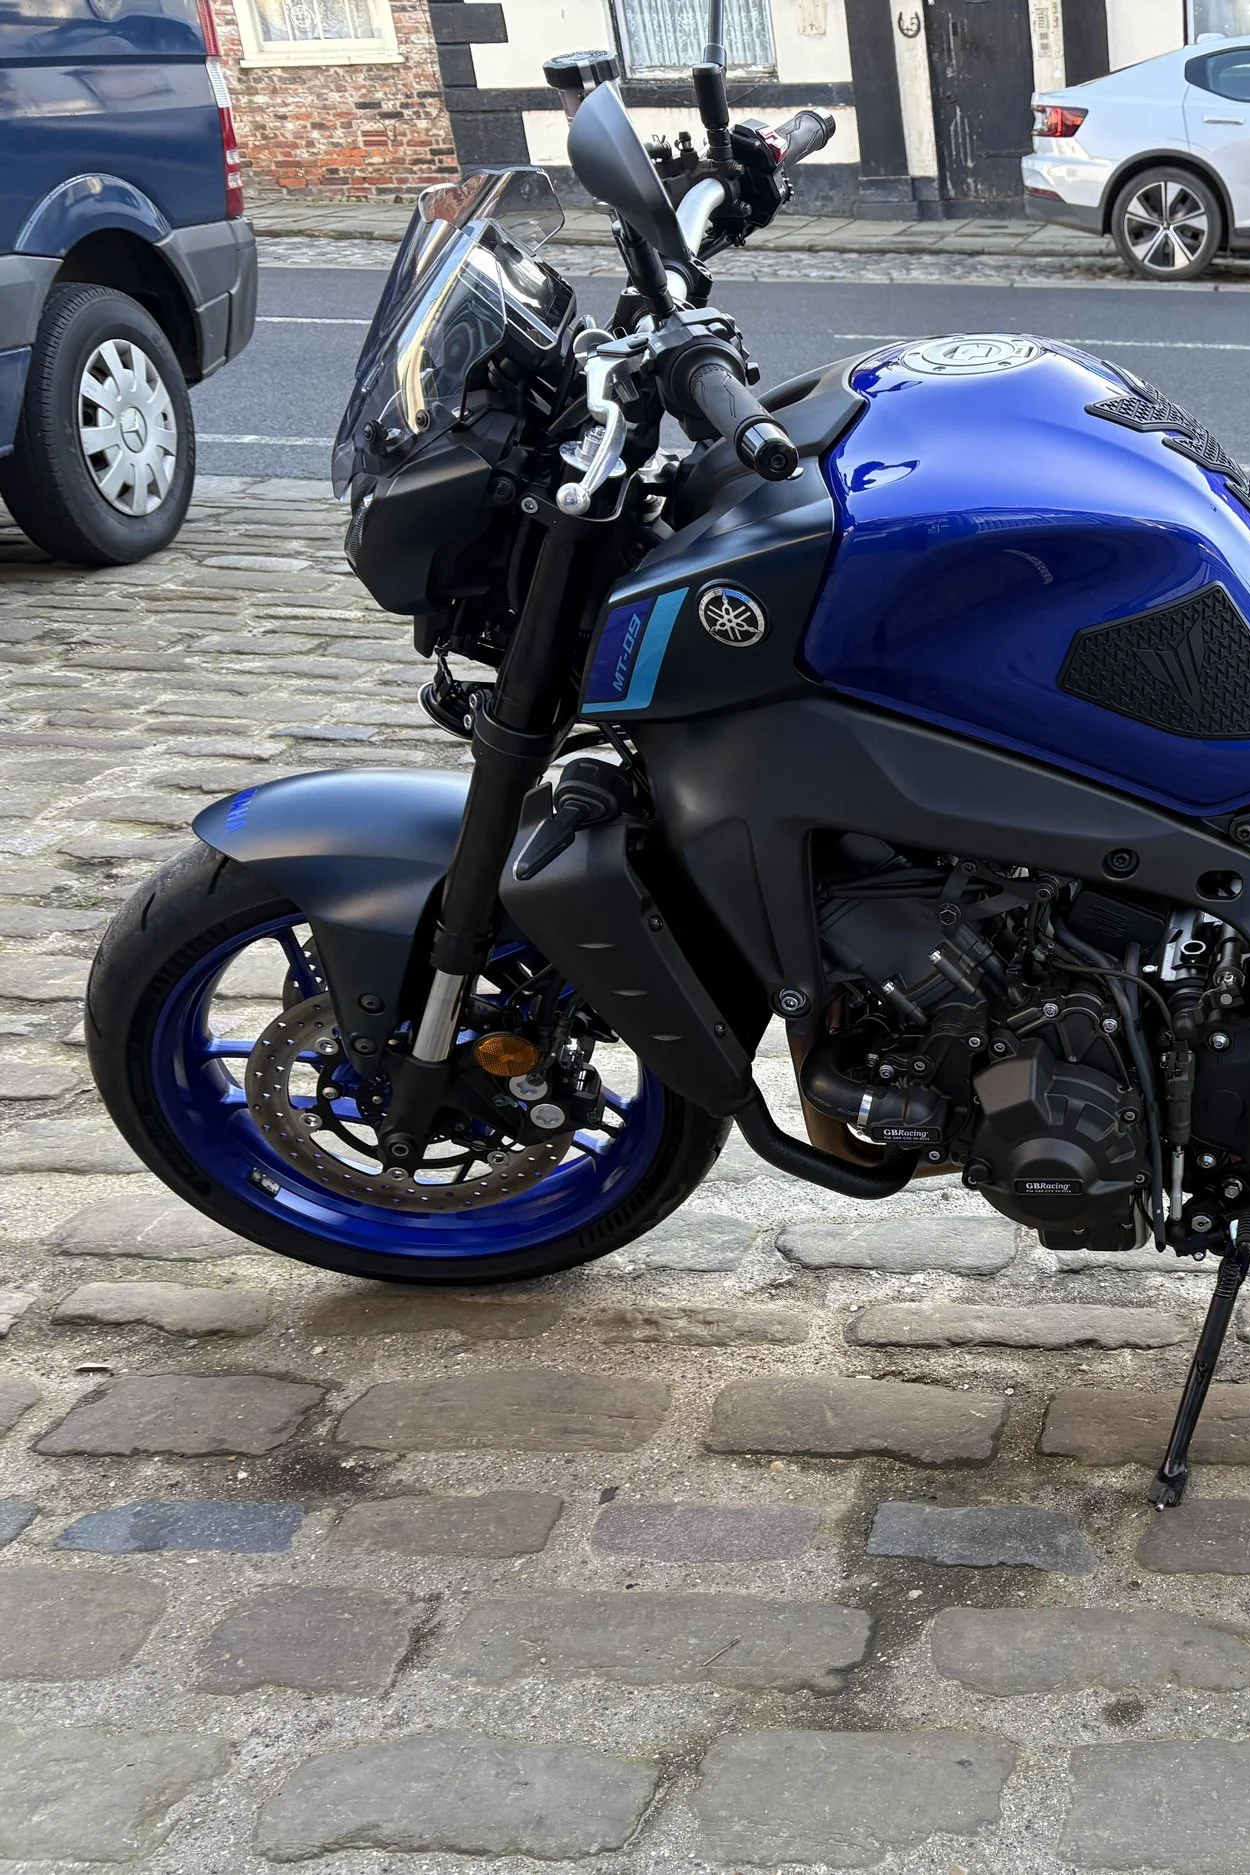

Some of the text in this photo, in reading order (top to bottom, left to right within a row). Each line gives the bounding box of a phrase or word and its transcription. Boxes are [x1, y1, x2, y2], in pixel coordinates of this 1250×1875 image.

[613, 613, 641, 692] MT-09
[225, 786, 257, 834] AHA
[883, 1129, 927, 1138] GBRacing
[1025, 1182, 1069, 1190] GBRacing
